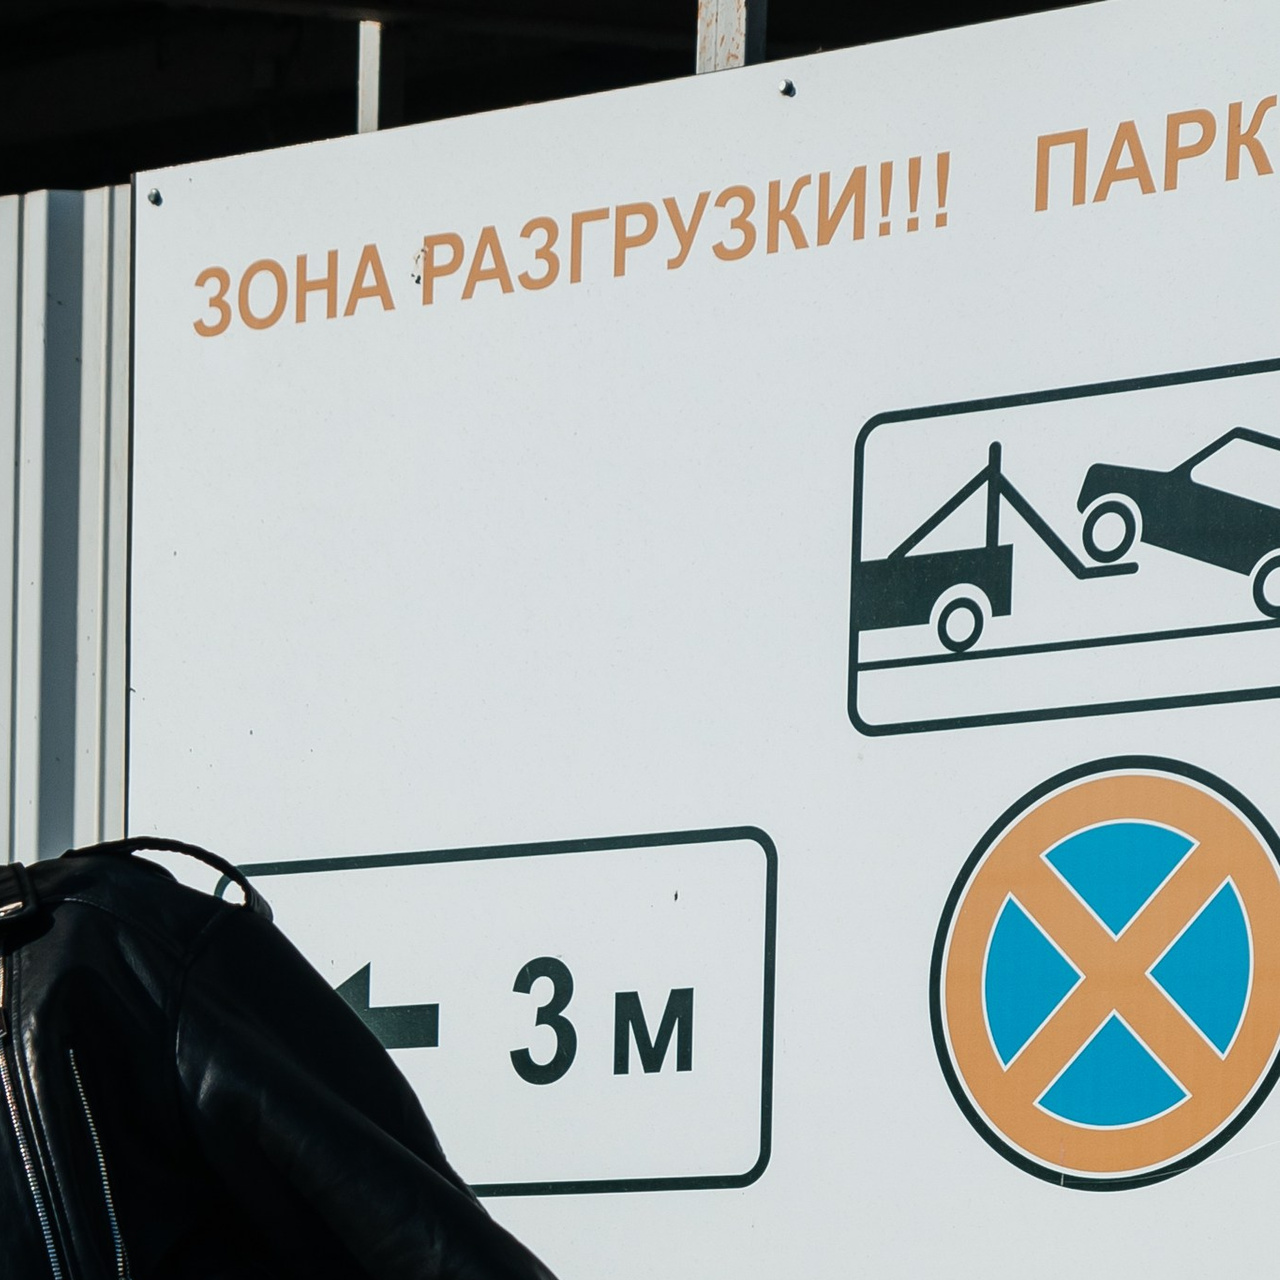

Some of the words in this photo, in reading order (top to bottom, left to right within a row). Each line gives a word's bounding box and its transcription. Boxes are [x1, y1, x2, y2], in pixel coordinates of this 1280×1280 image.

[193, 244, 395, 338] ЗОНА
[421, 151, 950, 306] РАЗГРУЗКИ!!!
[1033, 95, 1278, 212] ПАРК
[509, 956, 577, 1085] 3
